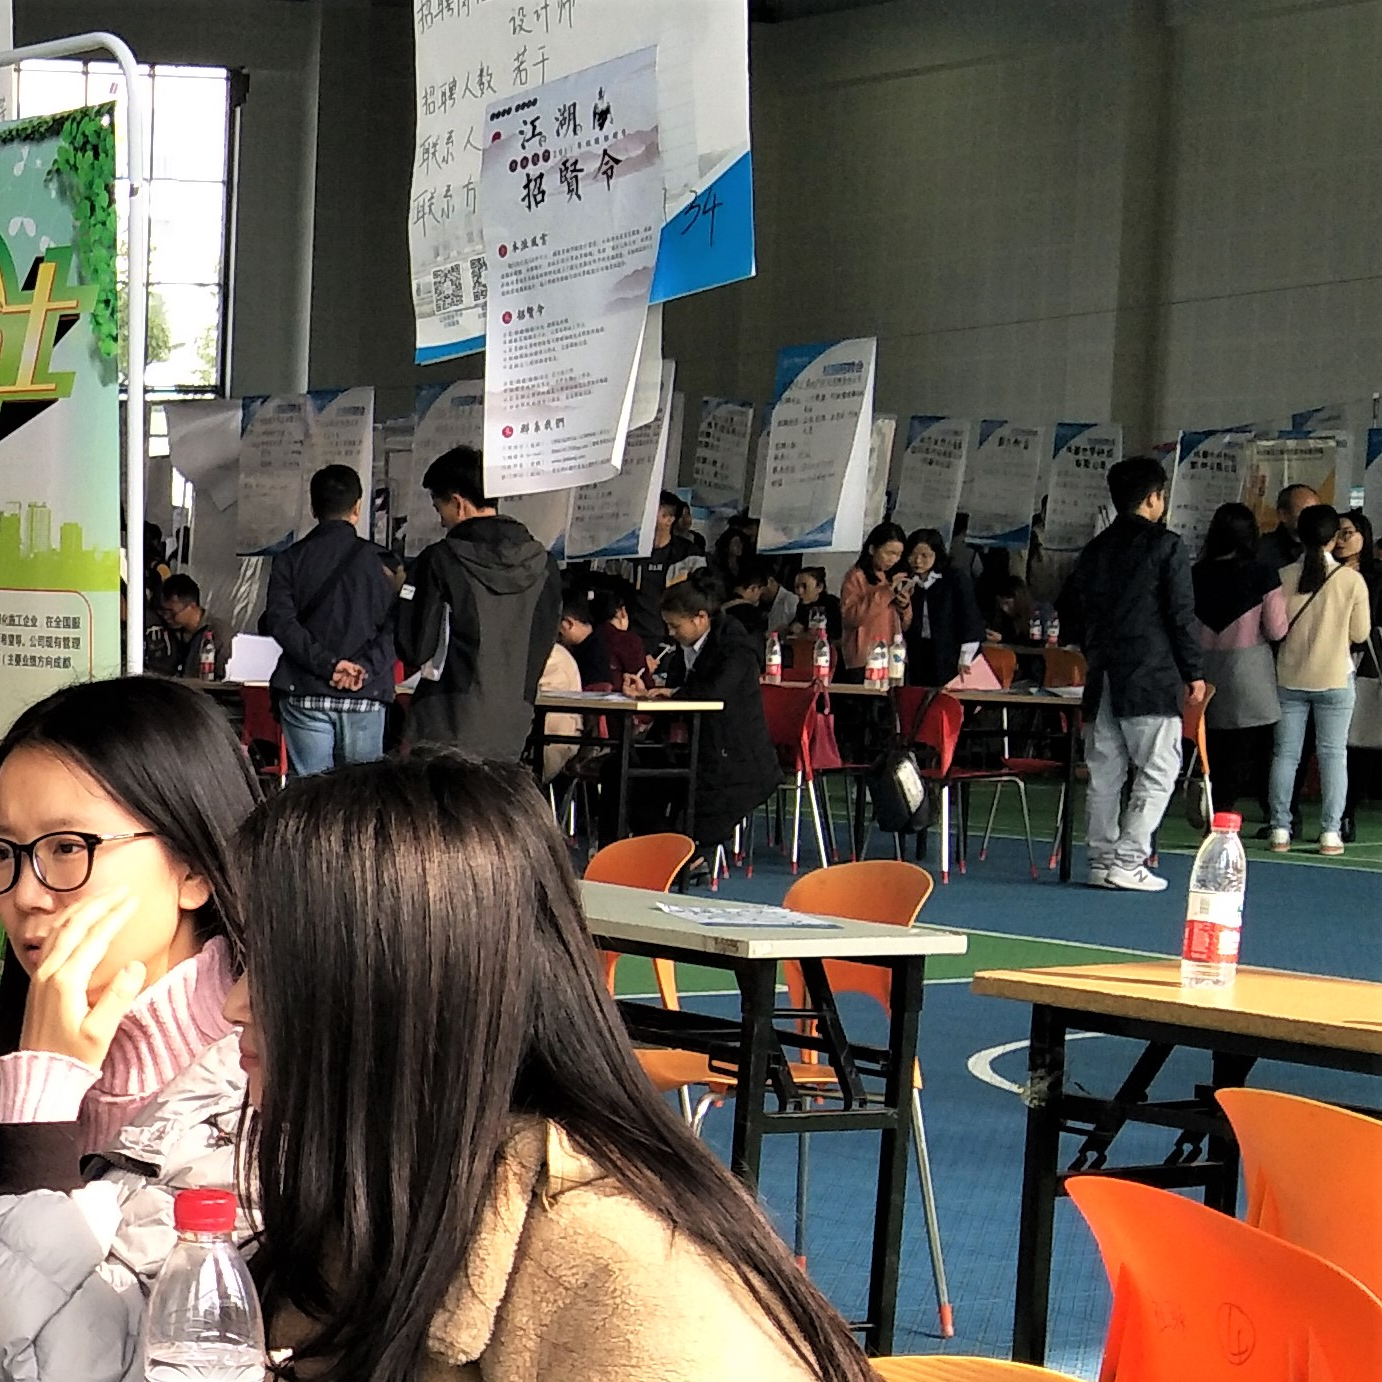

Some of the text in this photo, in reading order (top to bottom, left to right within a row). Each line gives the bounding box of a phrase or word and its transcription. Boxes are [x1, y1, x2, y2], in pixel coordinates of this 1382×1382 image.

[422, 60, 497, 116] 招聘人数
[512, 45, 550, 86] 若干
[419, 126, 482, 176] 联系人
[518, 102, 583, 150] 江湖
